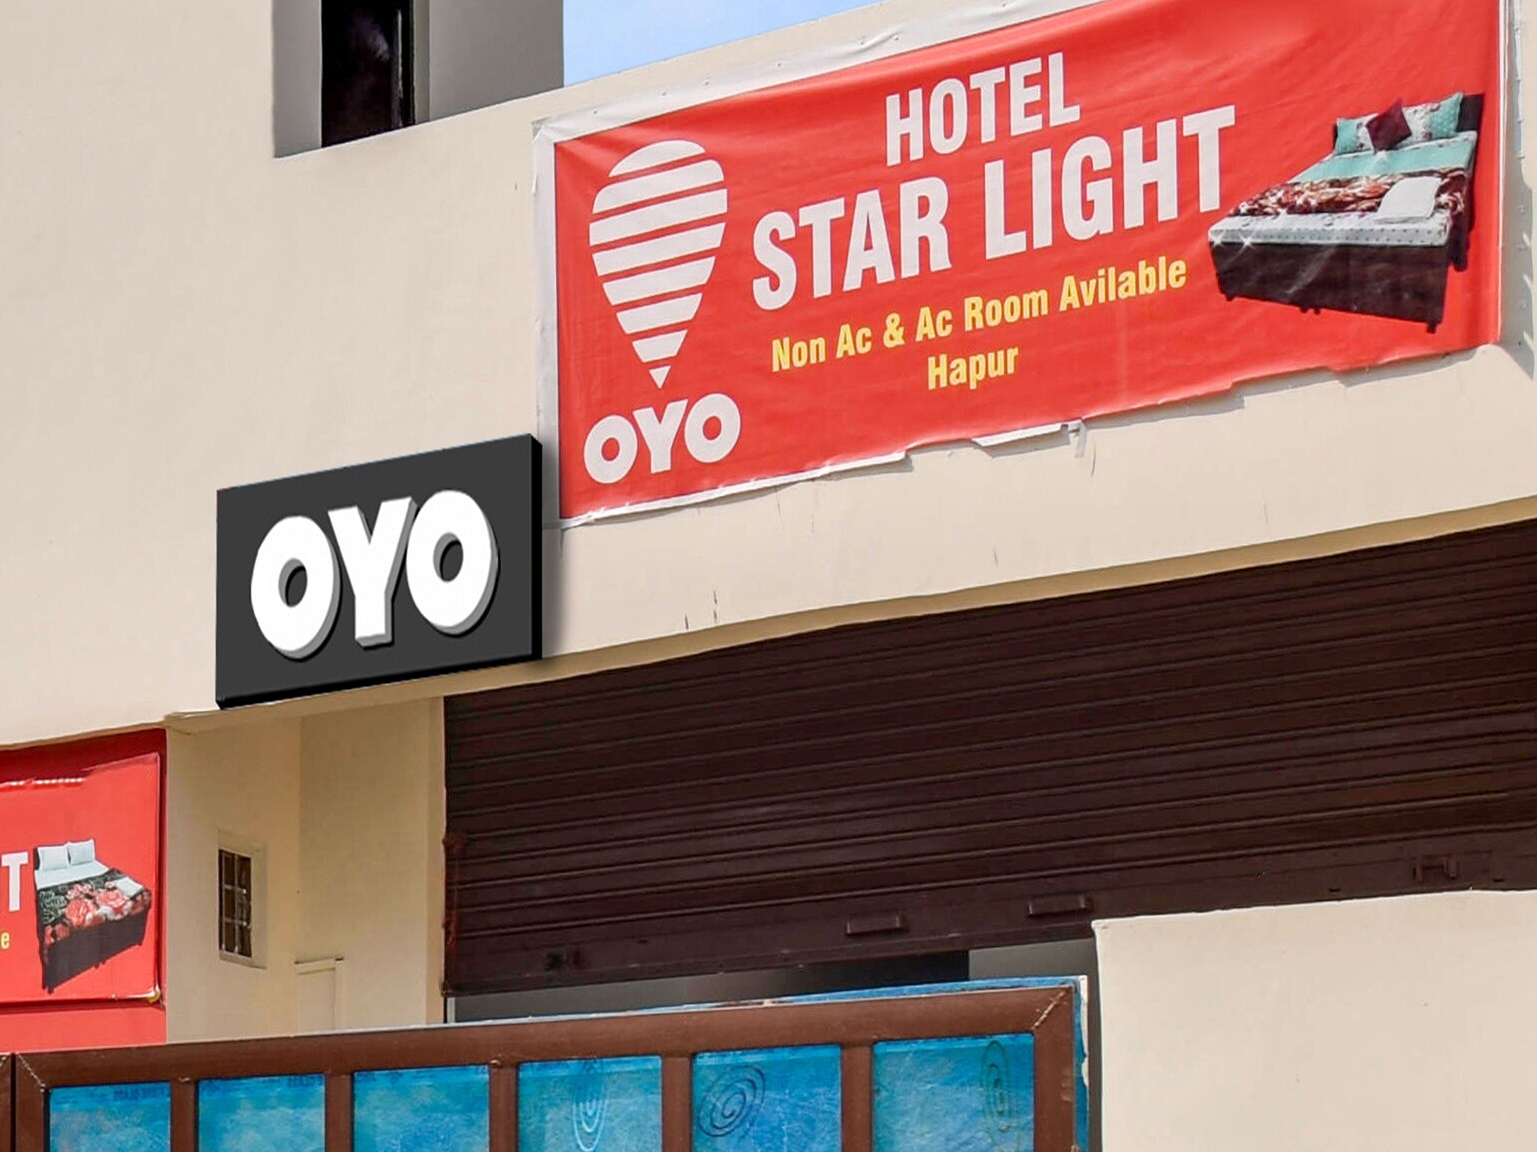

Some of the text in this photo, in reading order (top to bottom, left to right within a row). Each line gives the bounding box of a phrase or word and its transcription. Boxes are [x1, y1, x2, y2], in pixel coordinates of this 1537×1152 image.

[887, 53, 1080, 166] HOTEL
[753, 105, 1235, 309] STAR LIGHT
[773, 256, 1186, 371] Non Ac & Ac Room Avilable
[928, 348, 1018, 389] Hapur
[584, 394, 740, 483] OYO
[251, 490, 498, 658] OYO
